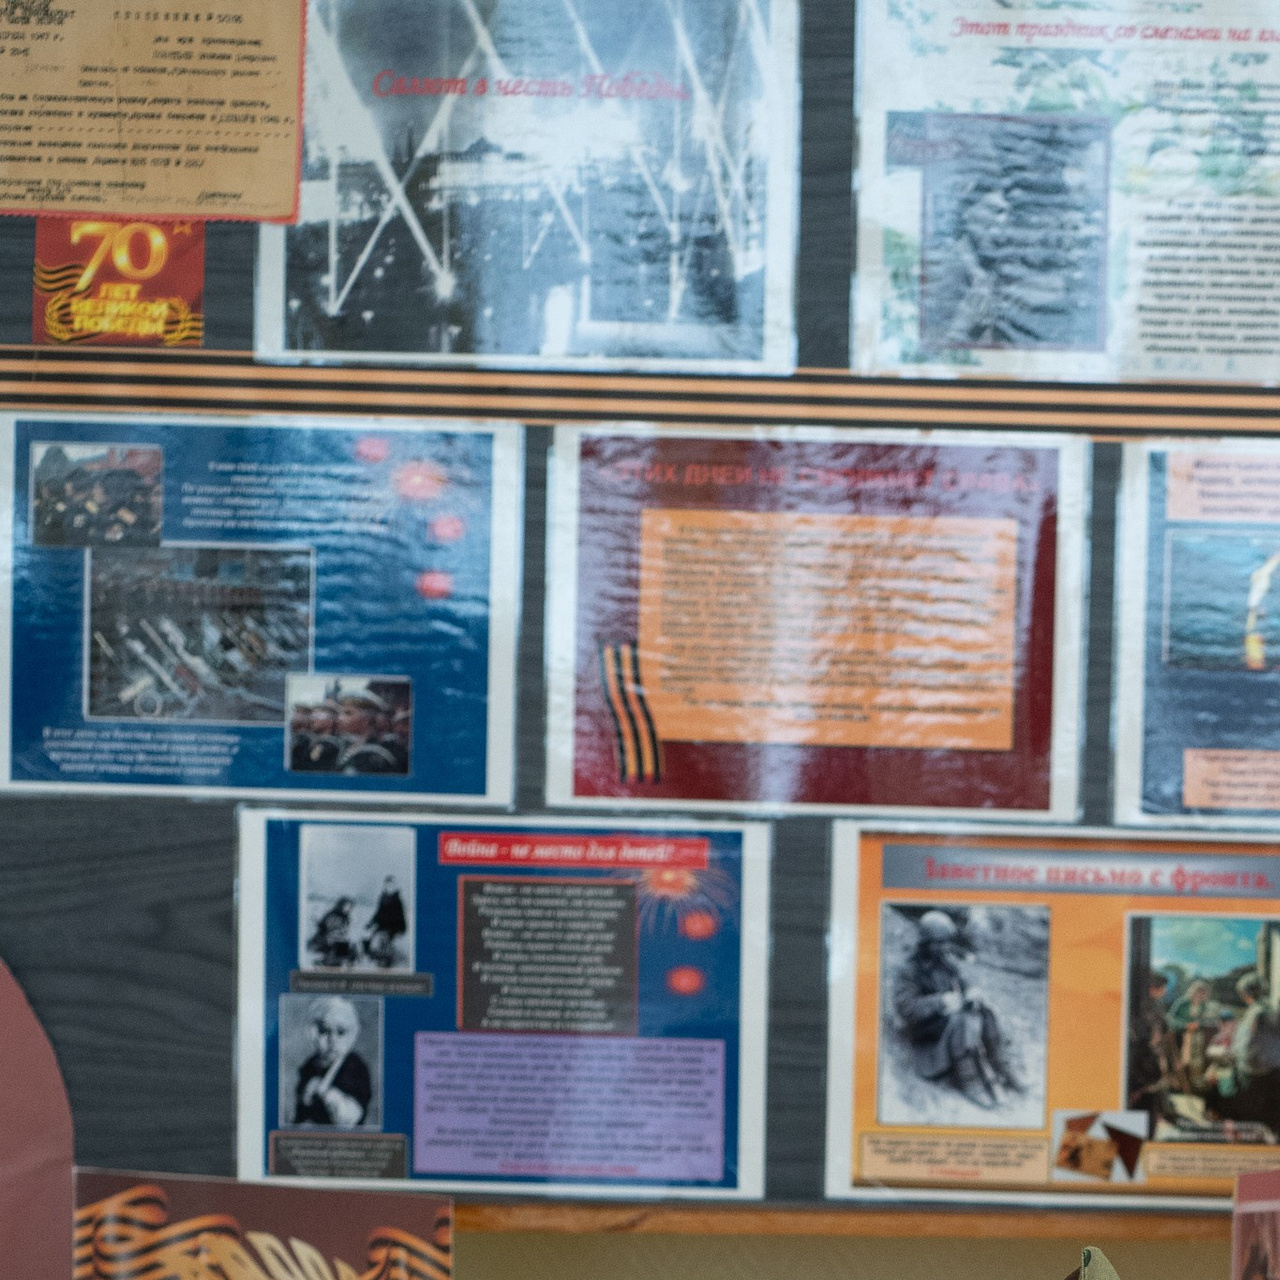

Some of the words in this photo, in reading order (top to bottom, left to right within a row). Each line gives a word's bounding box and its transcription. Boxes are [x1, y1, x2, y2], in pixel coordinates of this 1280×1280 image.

[371, 69, 467, 97] Салют
[472, 76, 488, 97] в
[493, 75, 574, 97] честь
[580, 71, 691, 100] Победы
[70, 221, 169, 291] 70
[99, 283, 143, 300] ЛЕТ
[683, 463, 752, 488] ДНЕЙ
[1044, 865, 1143, 886] письмо
[1149, 869, 1162, 886] с
[1170, 863, 1275, 893] фронта.
